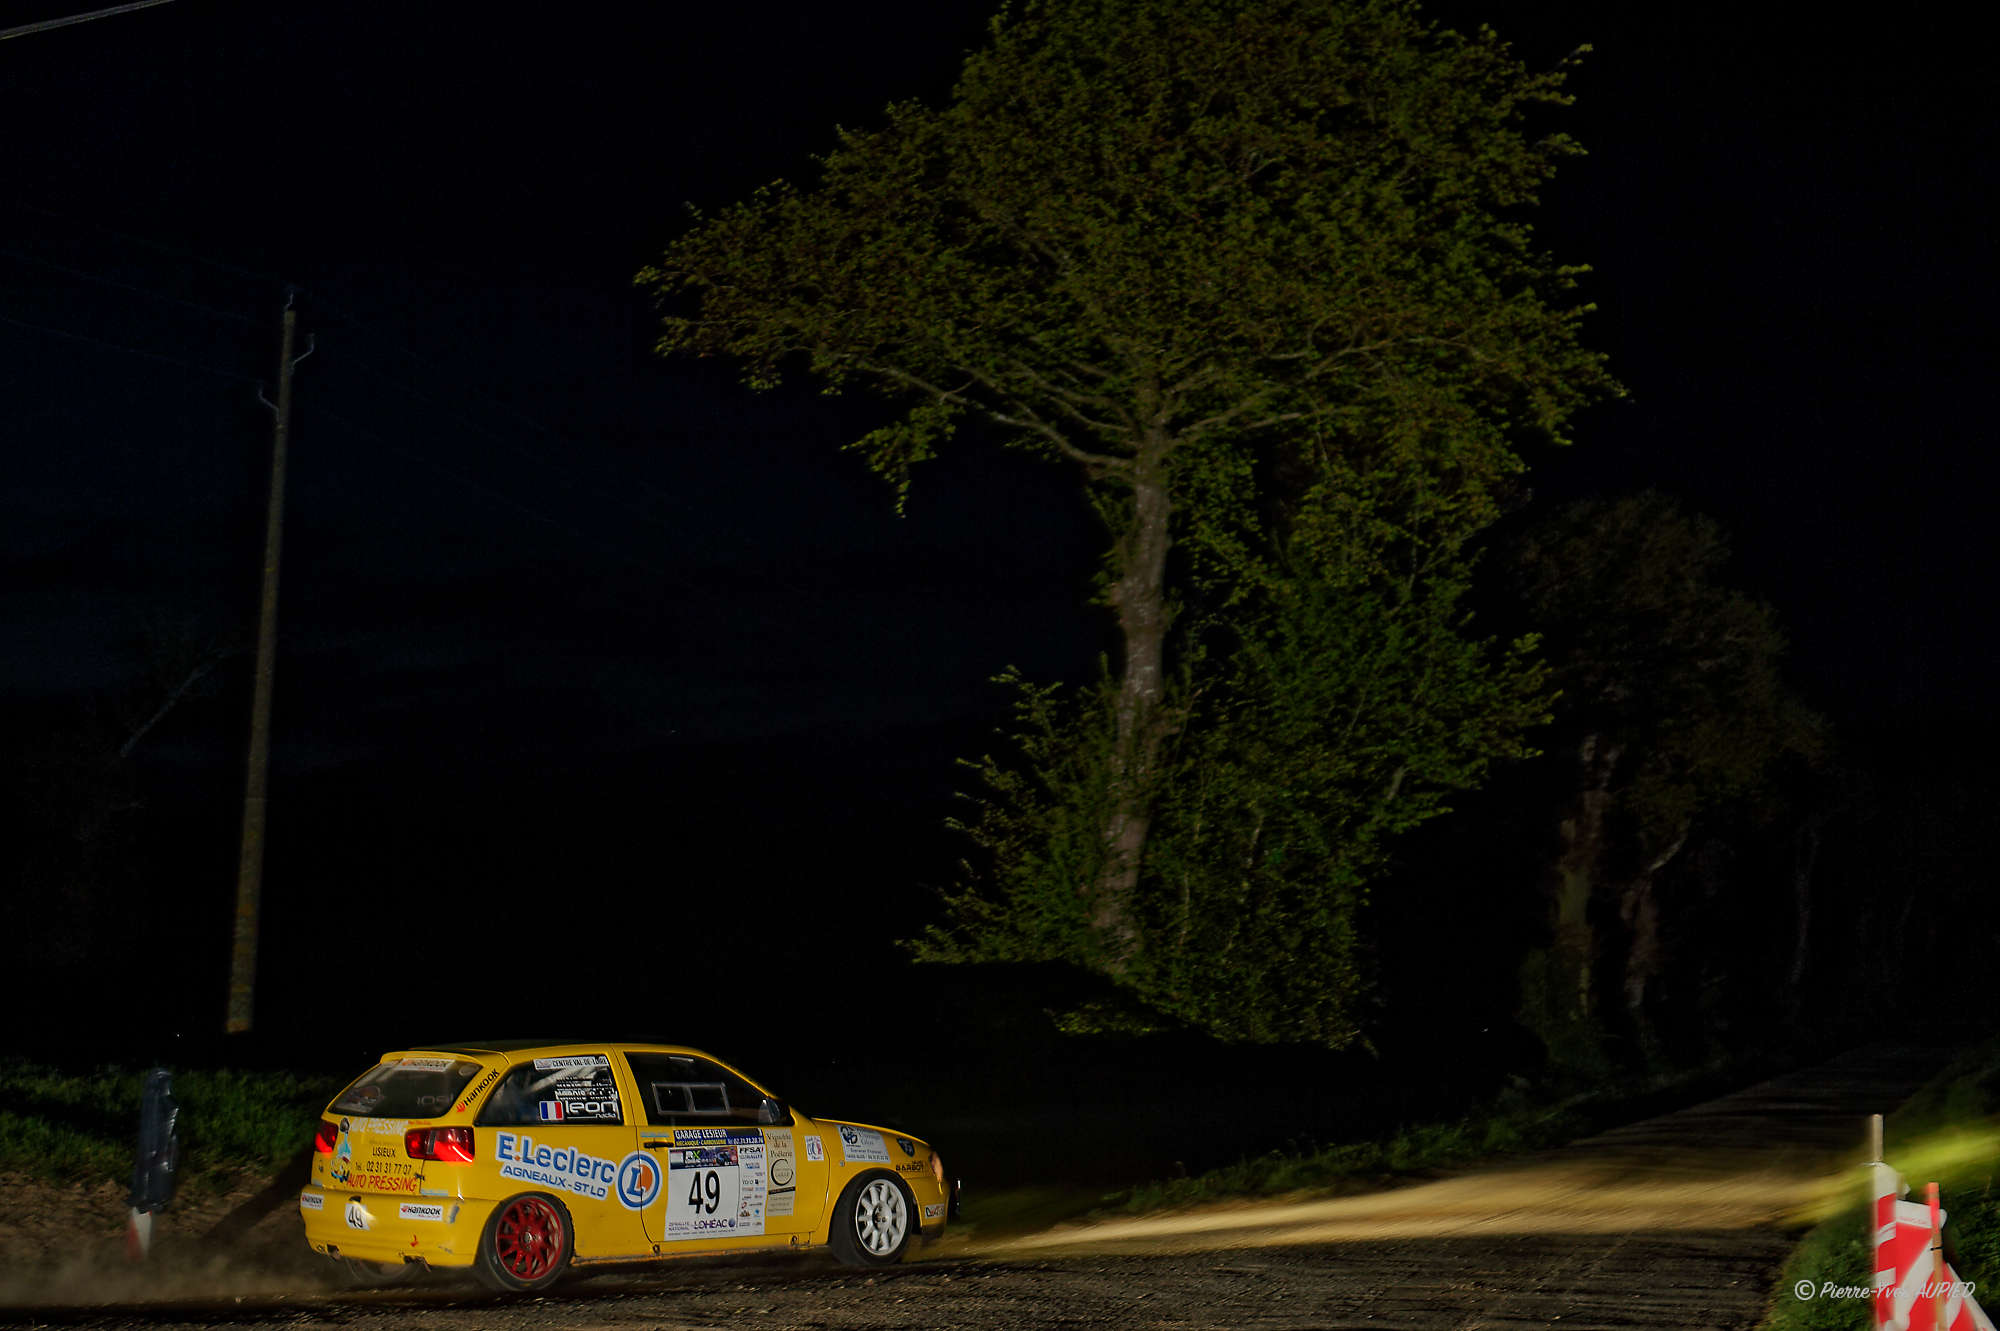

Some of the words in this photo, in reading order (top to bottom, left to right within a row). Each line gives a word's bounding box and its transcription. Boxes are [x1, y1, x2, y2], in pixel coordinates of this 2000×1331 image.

[675, 1129, 701, 1139] GARAGE
[498, 1134, 615, 1184] E.Leclerc
[347, 1172, 367, 1189] AUTO
[368, 1174, 417, 1193] PRESSING
[503, 1165, 567, 1188] AGNEAUX
[688, 1170, 720, 1215] 49
